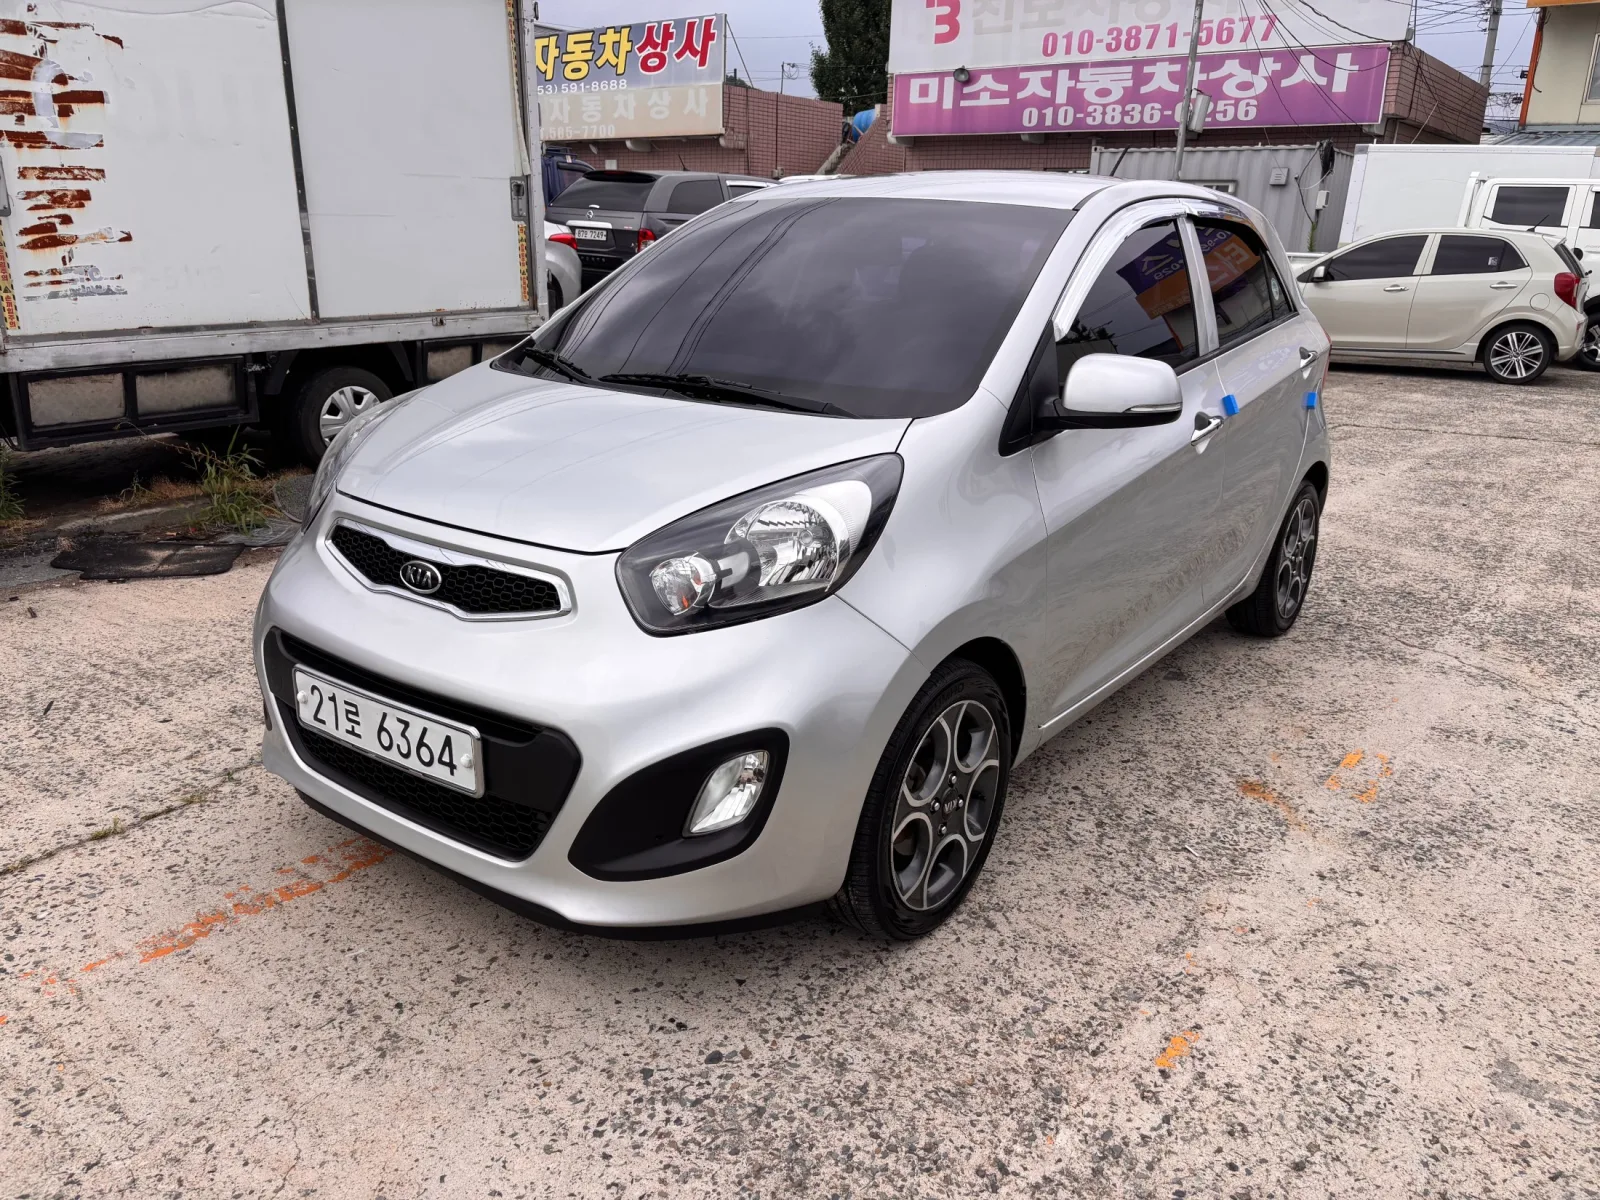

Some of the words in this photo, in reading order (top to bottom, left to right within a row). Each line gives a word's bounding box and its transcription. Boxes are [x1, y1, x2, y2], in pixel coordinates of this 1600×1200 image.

[1042, 15, 1277, 57] 010-3871-5677
[310, 684, 362, 739] 21로
[377, 711, 457, 776] 6364
